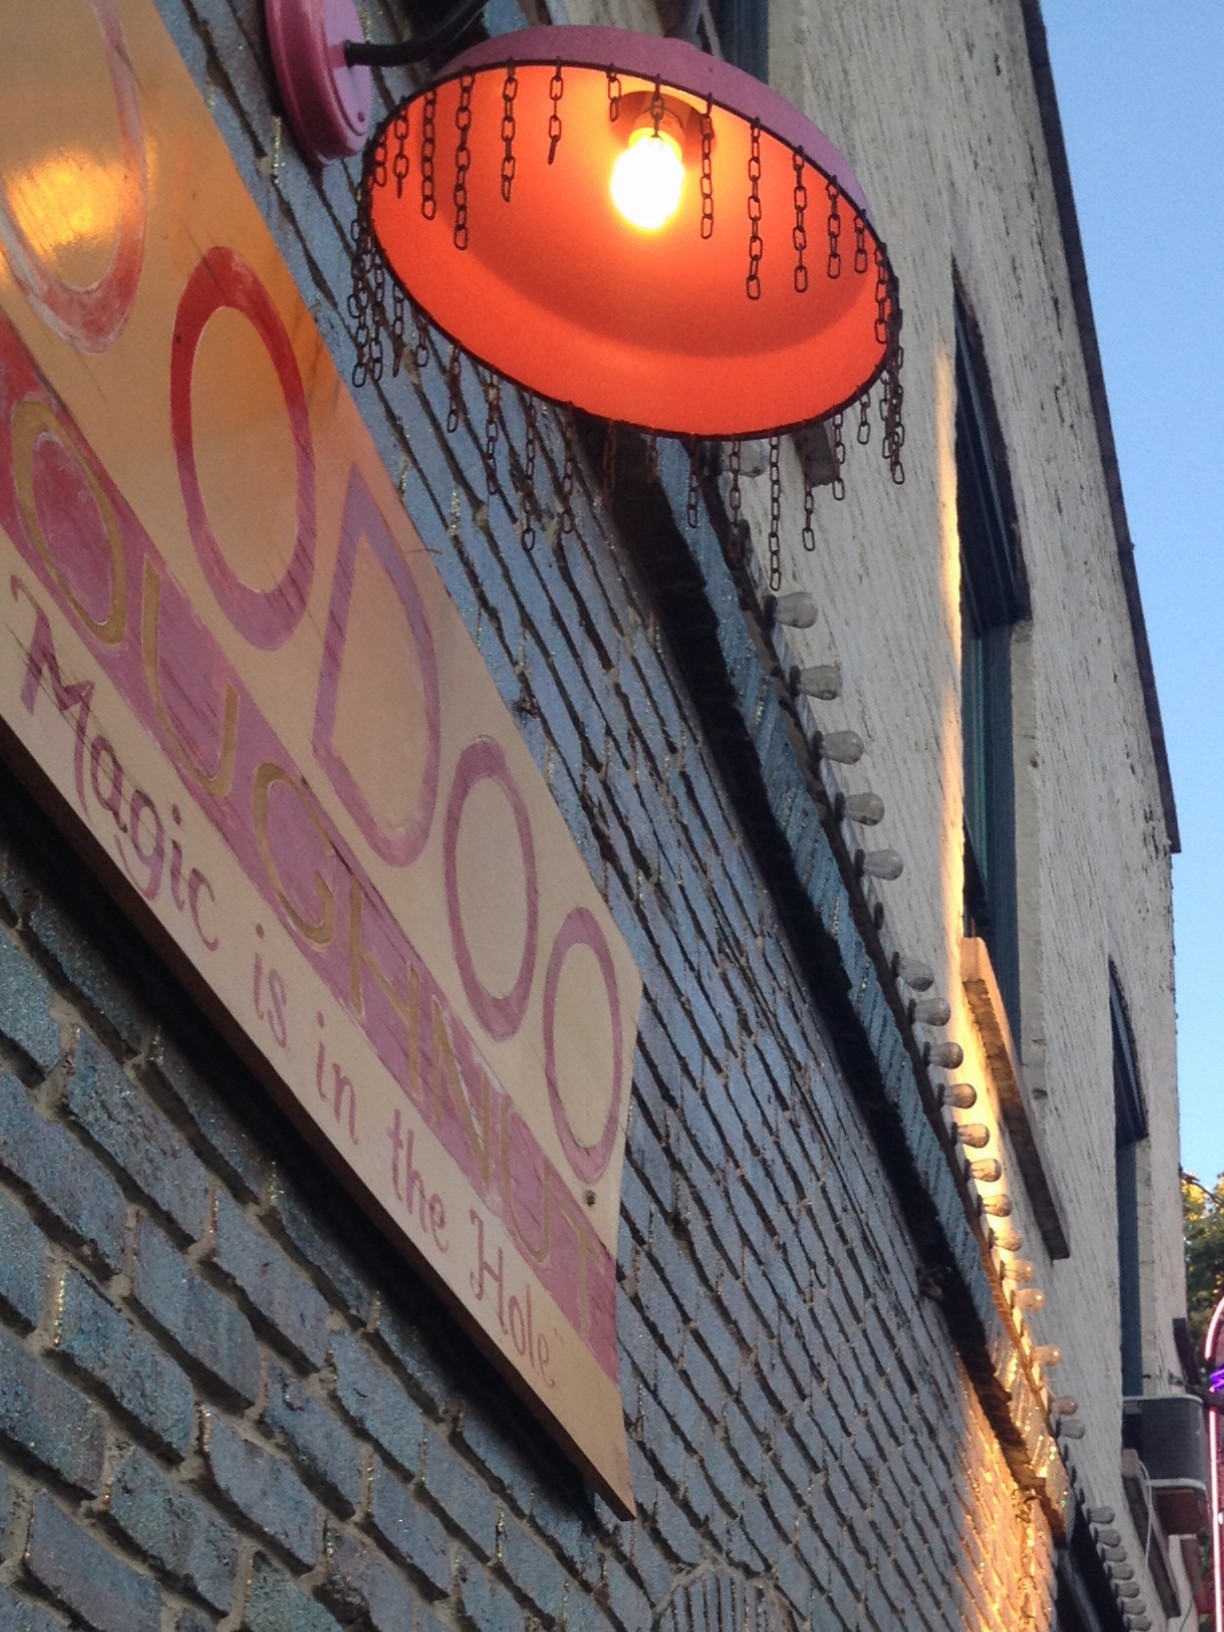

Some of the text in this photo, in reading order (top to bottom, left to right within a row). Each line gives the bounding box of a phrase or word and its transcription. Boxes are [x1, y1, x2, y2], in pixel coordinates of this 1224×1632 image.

[0, 0, 622, 1184] OODOO
[10, 575, 219, 953] Magic
[252, 925, 289, 1049] is
[316, 1011, 361, 1146] in
[387, 1109, 450, 1254] the
[12, 396, 603, 1342] OUGHNUT
